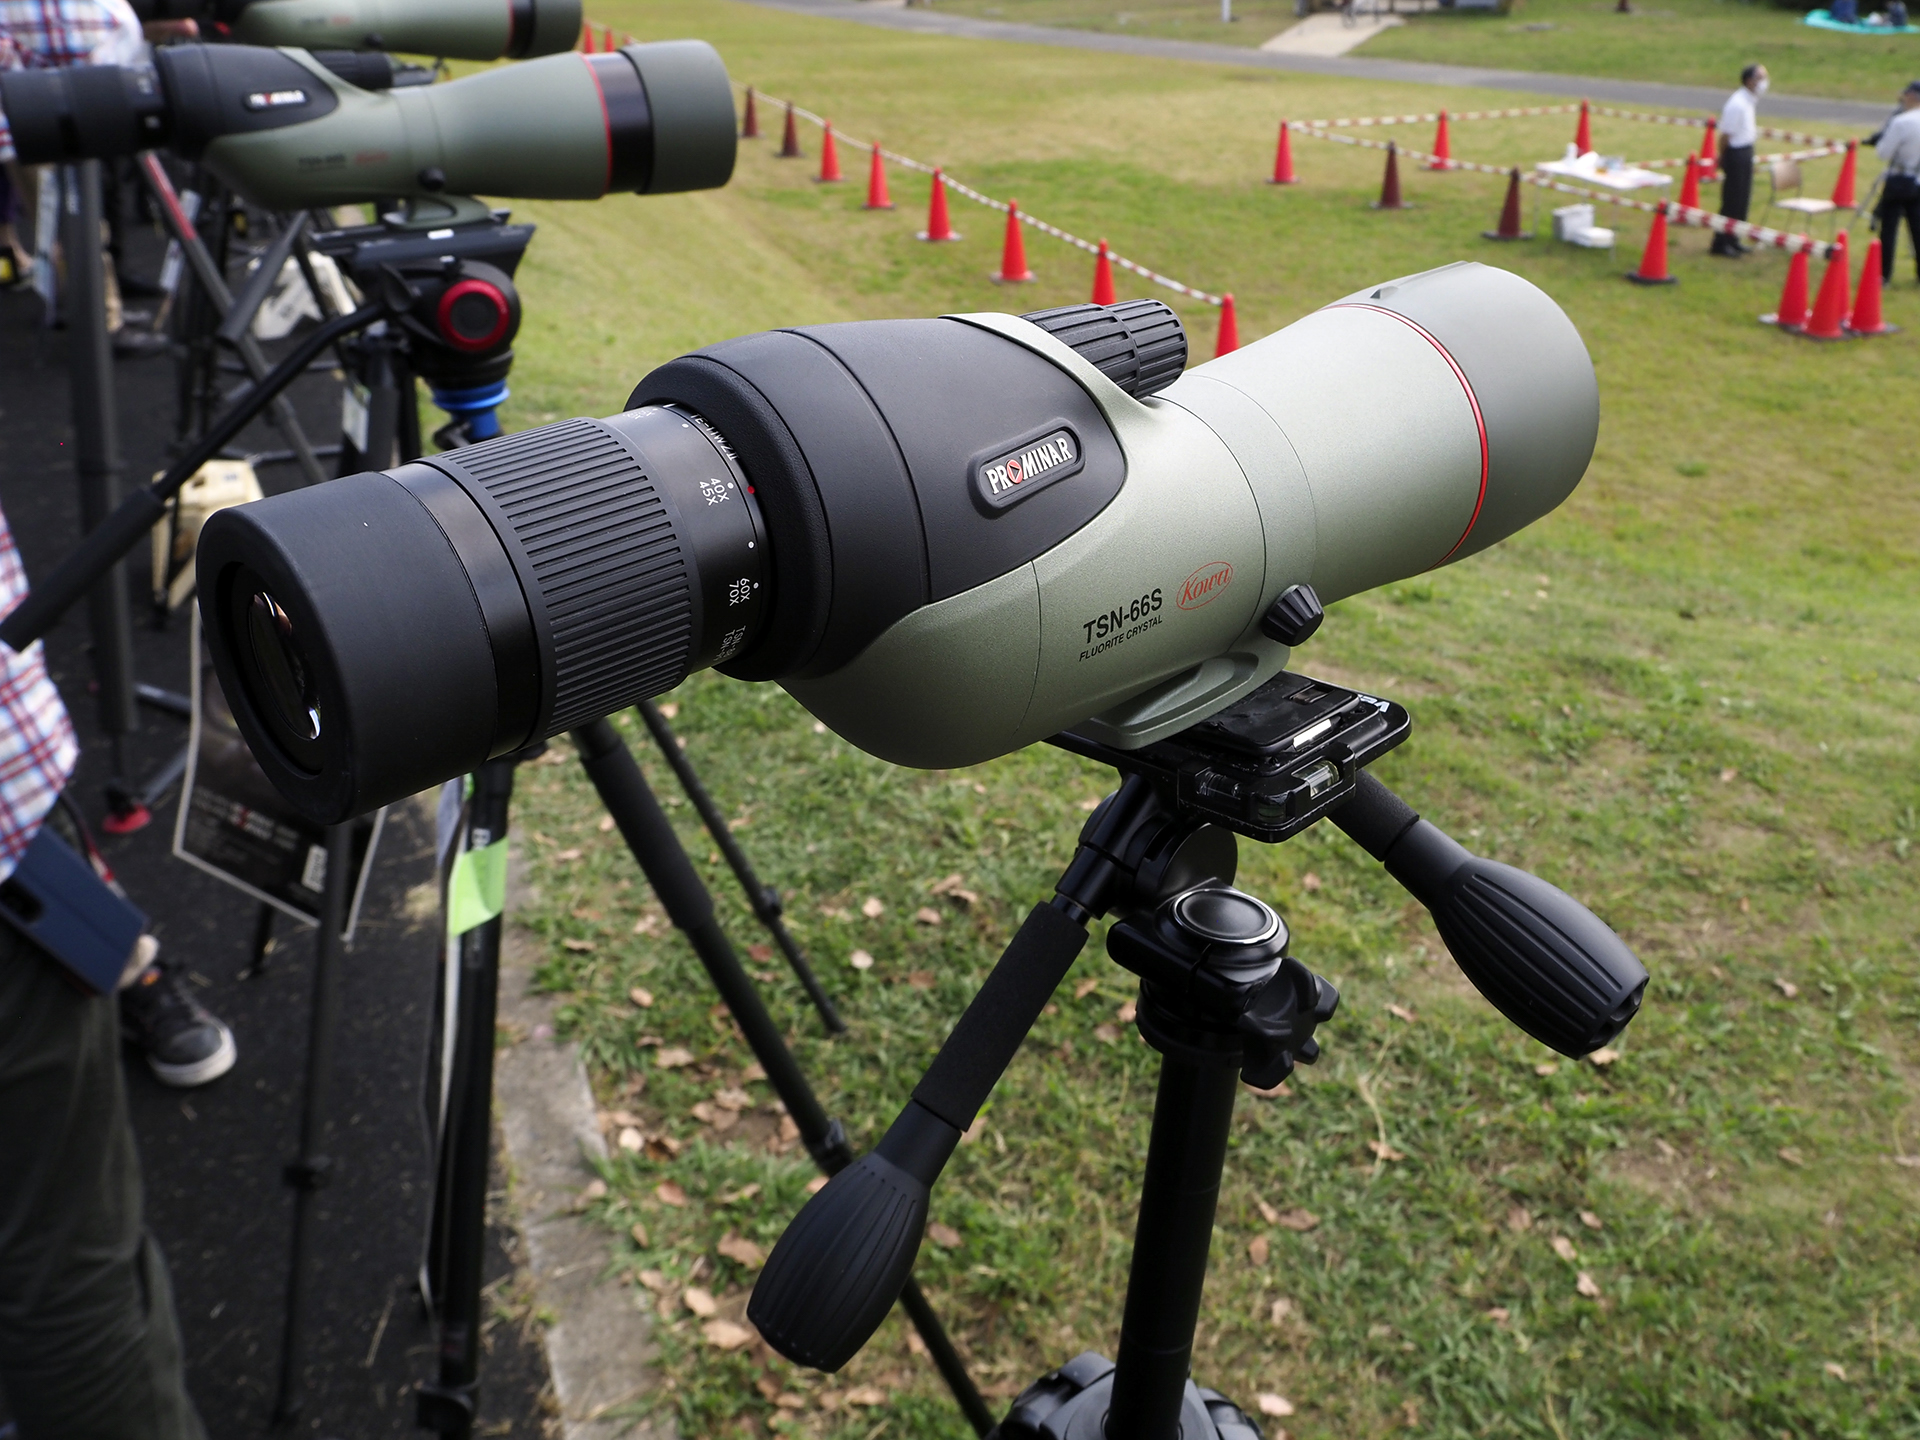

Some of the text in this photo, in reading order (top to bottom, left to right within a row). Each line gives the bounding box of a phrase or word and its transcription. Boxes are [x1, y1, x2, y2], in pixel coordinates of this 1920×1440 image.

[985, 438, 1073, 495] PROMINAR
[699, 481, 719, 506] 45X
[710, 477, 730, 502] 40X
[729, 580, 740, 606] 70X
[740, 577, 751, 602] 60X
[1180, 567, 1230, 606] Kowa
[1082, 587, 1163, 644] TSN-66S
[1078, 614, 1163, 662] FLUORITE CRYSTAL
